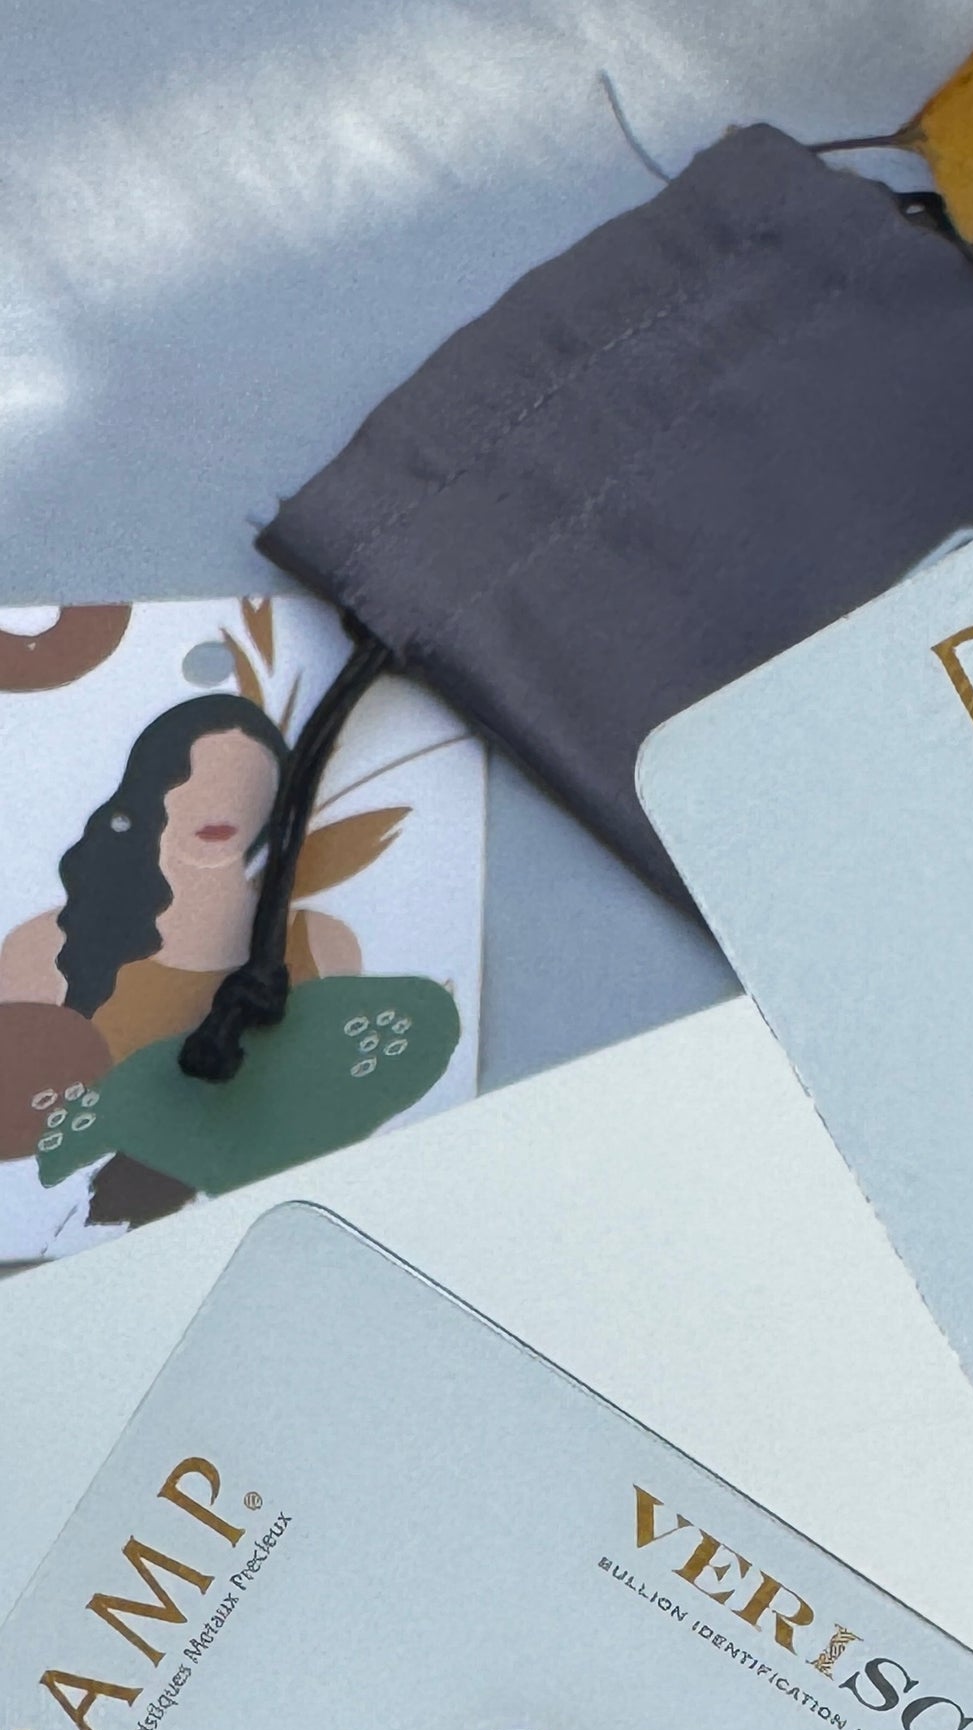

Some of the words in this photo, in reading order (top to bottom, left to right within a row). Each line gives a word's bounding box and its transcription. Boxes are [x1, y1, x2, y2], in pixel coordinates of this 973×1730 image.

[230, 1511, 292, 1590] Precieux
[598, 1557, 689, 1622] BULLION
[692, 1620, 847, 1730] IDENTIFICATION
